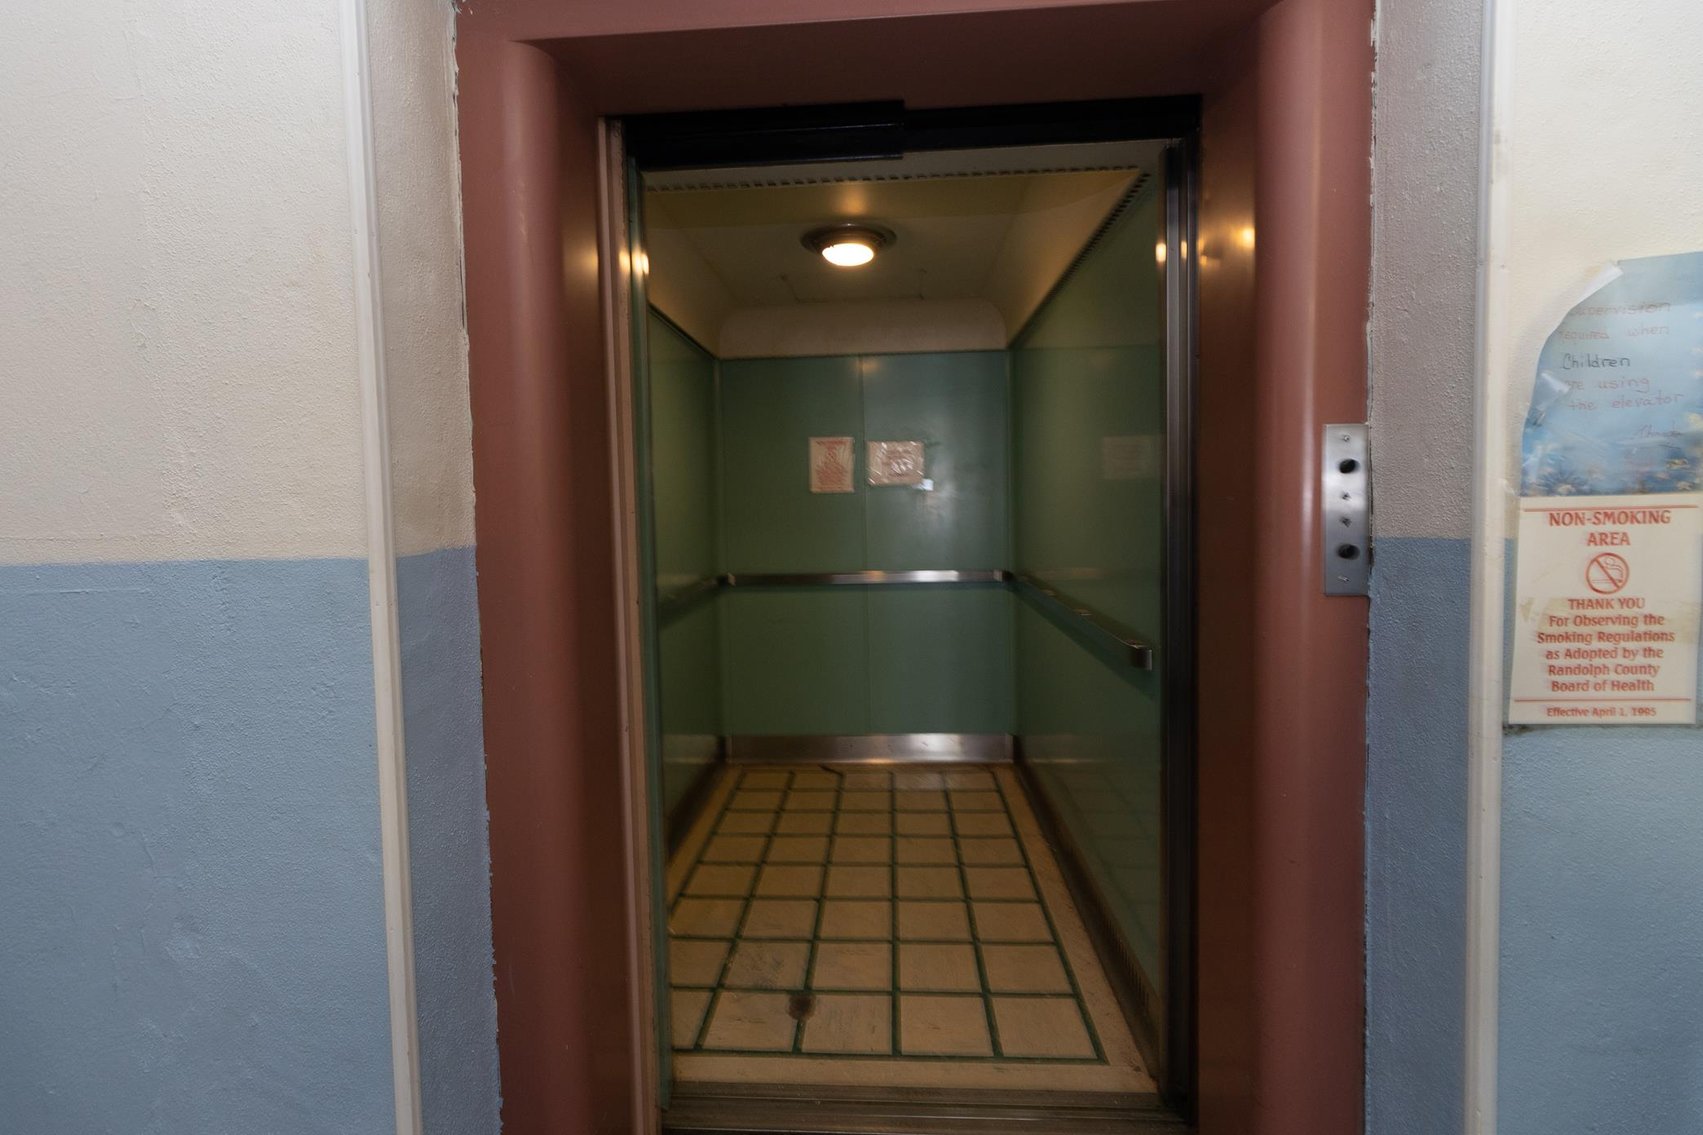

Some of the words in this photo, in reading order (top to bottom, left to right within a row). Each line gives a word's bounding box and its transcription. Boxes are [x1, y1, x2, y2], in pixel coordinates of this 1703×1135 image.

[1561, 353, 1631, 370] Children
[1598, 376, 1650, 393] using
[1610, 390, 1684, 409] elevator
[1549, 510, 1671, 526] NON-SMOKING
[1587, 532, 1631, 546] AREA
[1568, 599, 1614, 610] THANK
[1618, 598, 1645, 609] YOU
[1549, 615, 1569, 627] For
[1573, 614, 1638, 628] Observing
[1643, 613, 1665, 625] the
[1537, 632, 1593, 645] Smoking
[1597, 630, 1676, 644] Regulations
[1545, 651, 1560, 660] as
[1564, 648, 1618, 661] Adopted
[1622, 647, 1638, 660] by
[1642, 647, 1664, 658] the
[1548, 665, 1610, 678] Randolph
[1614, 664, 1660, 678] County
[1551, 680, 1589, 692] Board
[1593, 680, 1609, 691] of
[1611, 679, 1655, 691] Health
[1547, 707, 1589, 717] Effective
[1592, 707, 1616, 718] April
